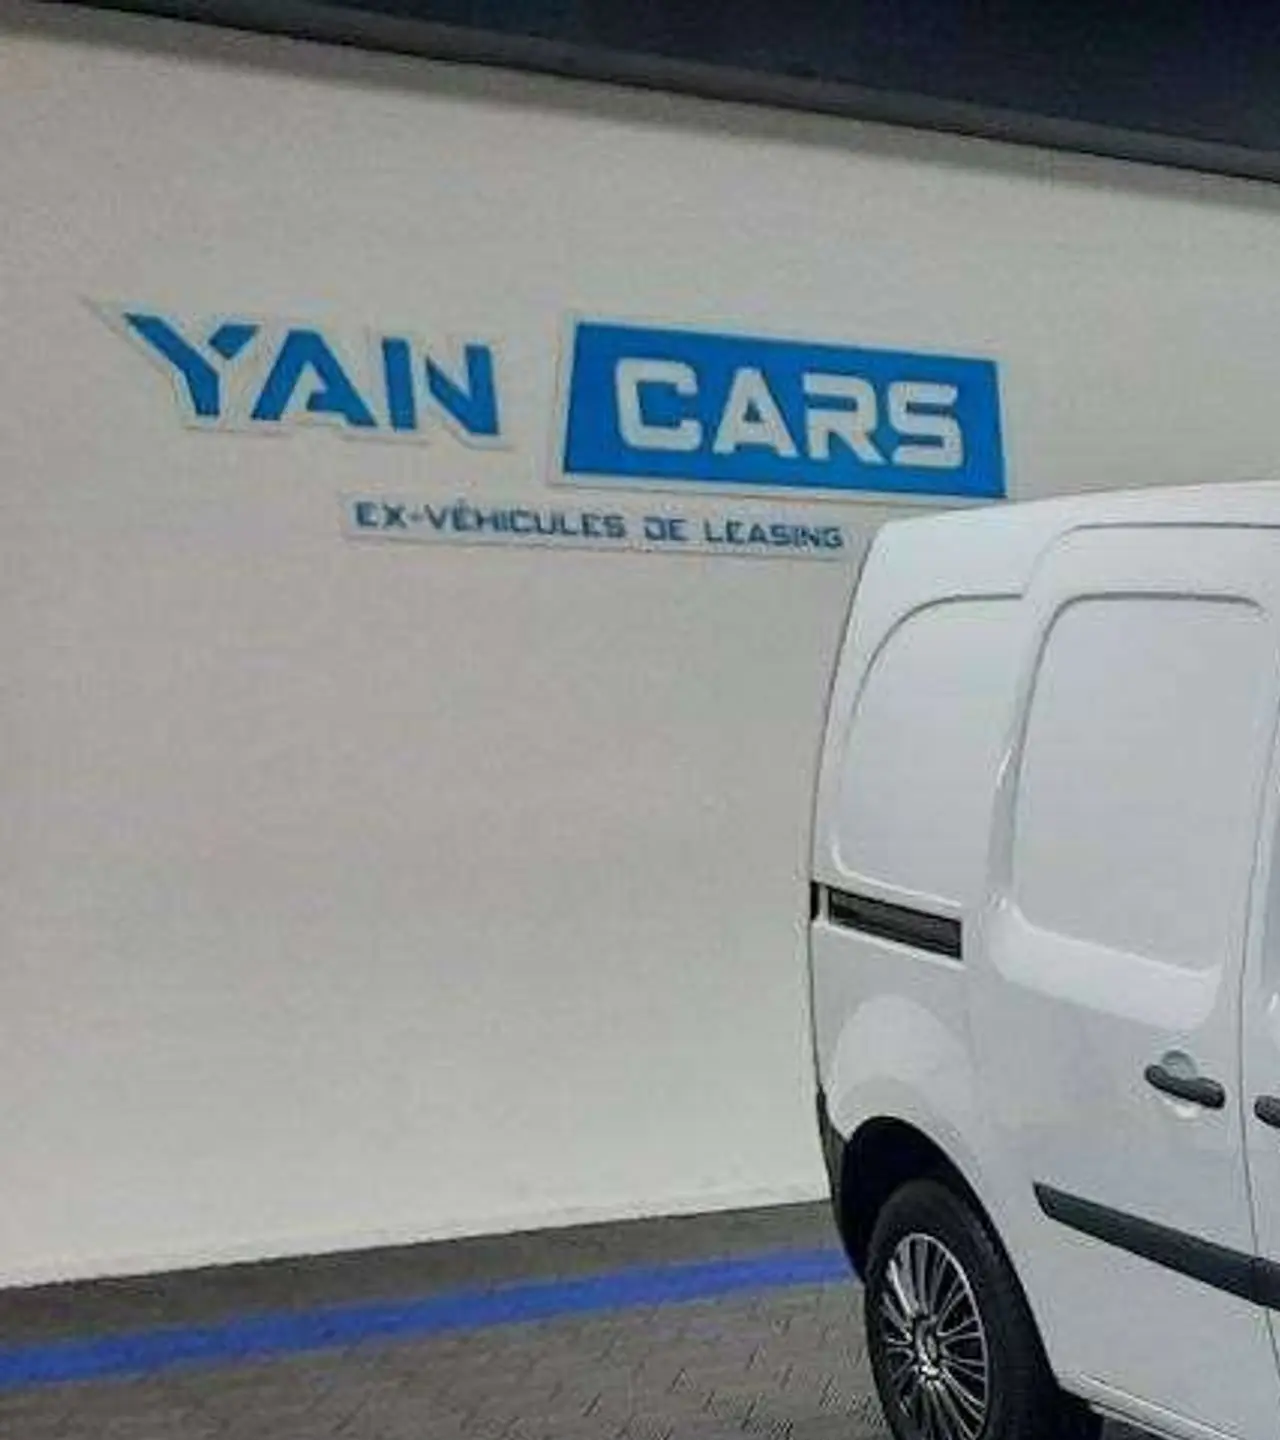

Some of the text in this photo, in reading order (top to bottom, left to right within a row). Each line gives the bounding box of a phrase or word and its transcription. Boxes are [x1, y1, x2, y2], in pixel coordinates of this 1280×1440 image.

[124, 312, 964, 468] YAN CARS
[354, 499, 843, 550] EX-VÉHICULES DE LEASING
